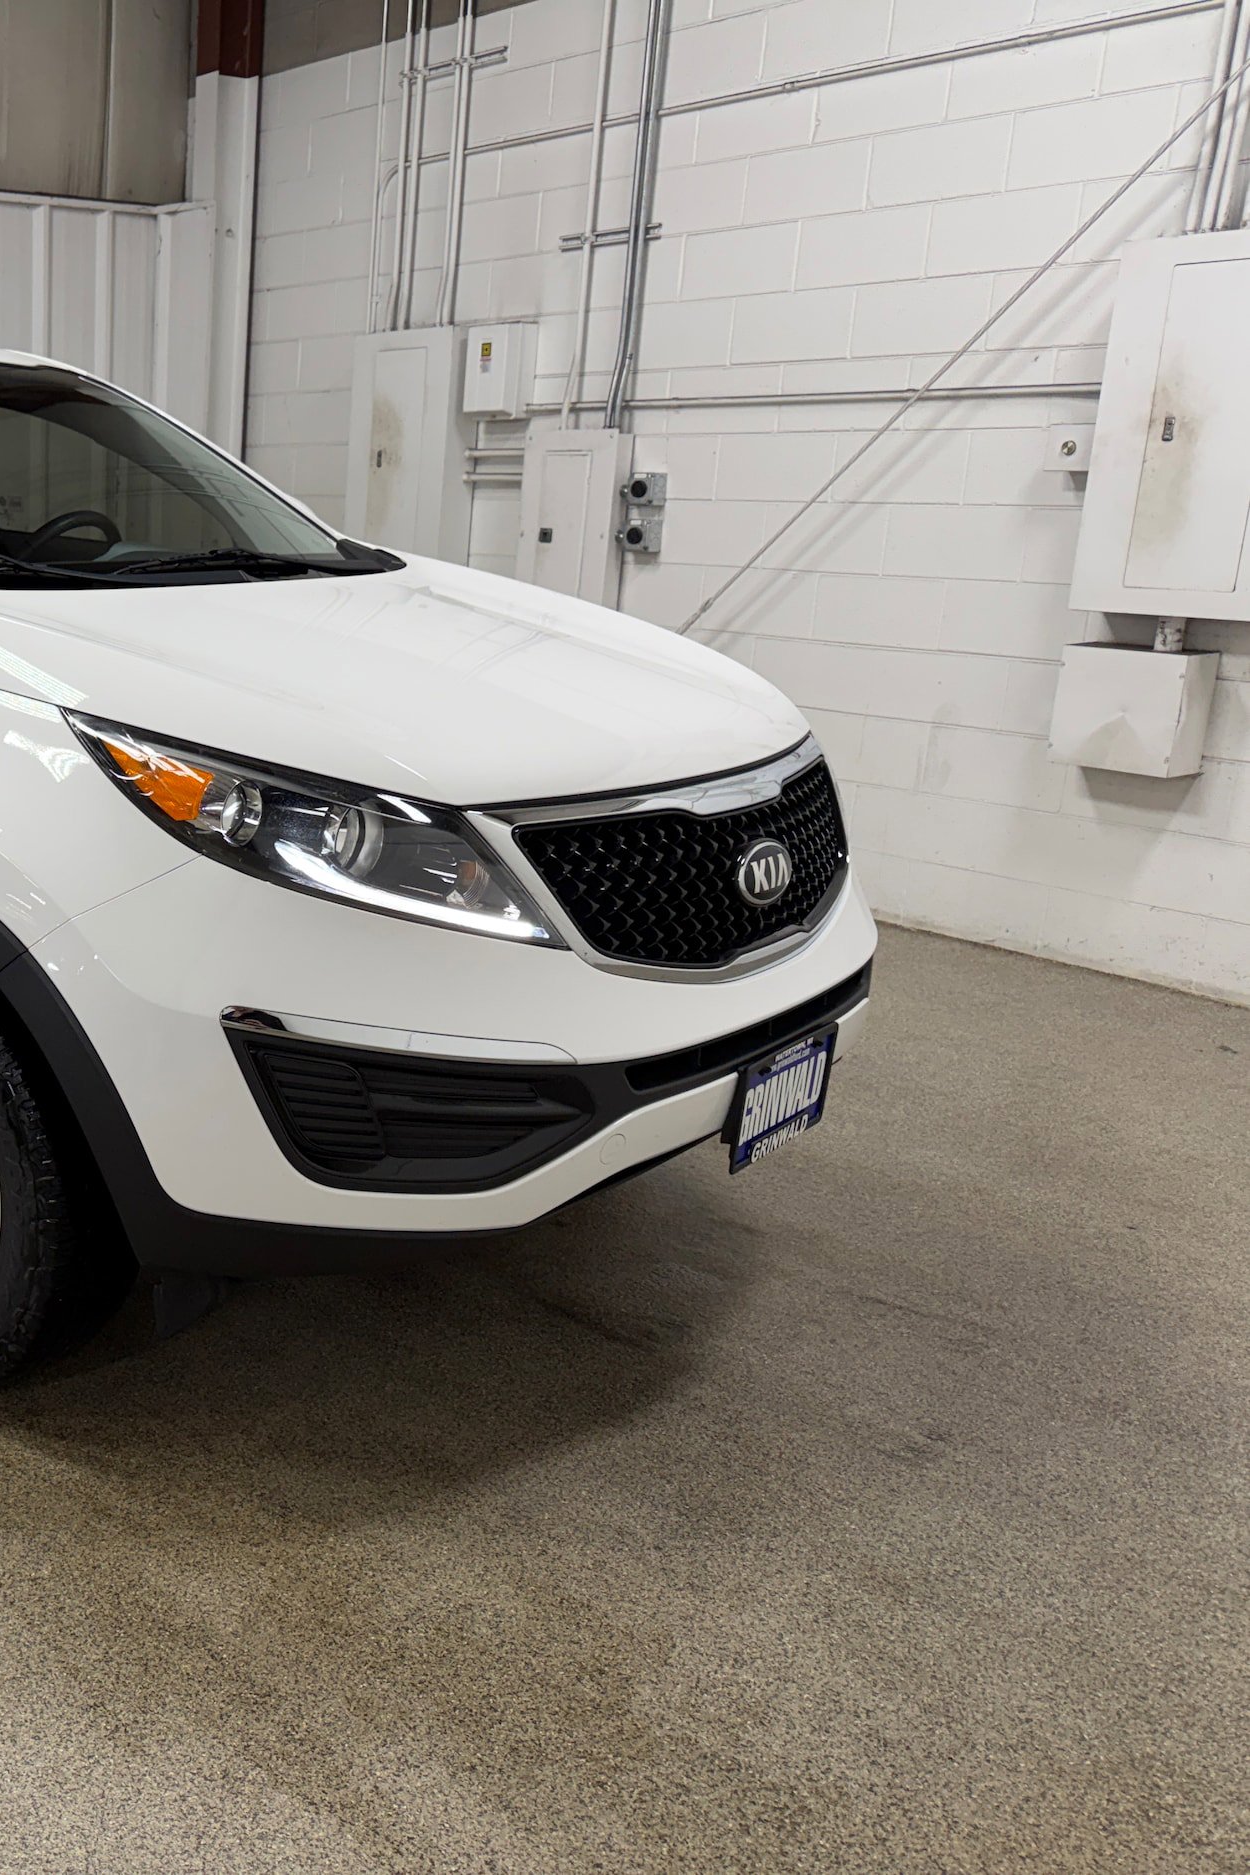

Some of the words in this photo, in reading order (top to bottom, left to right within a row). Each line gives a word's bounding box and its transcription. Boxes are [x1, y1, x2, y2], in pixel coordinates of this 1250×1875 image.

[750, 853, 790, 894] KIA
[738, 1051, 827, 1147] GRINWALD
[751, 1114, 809, 1163] GRINWALD
